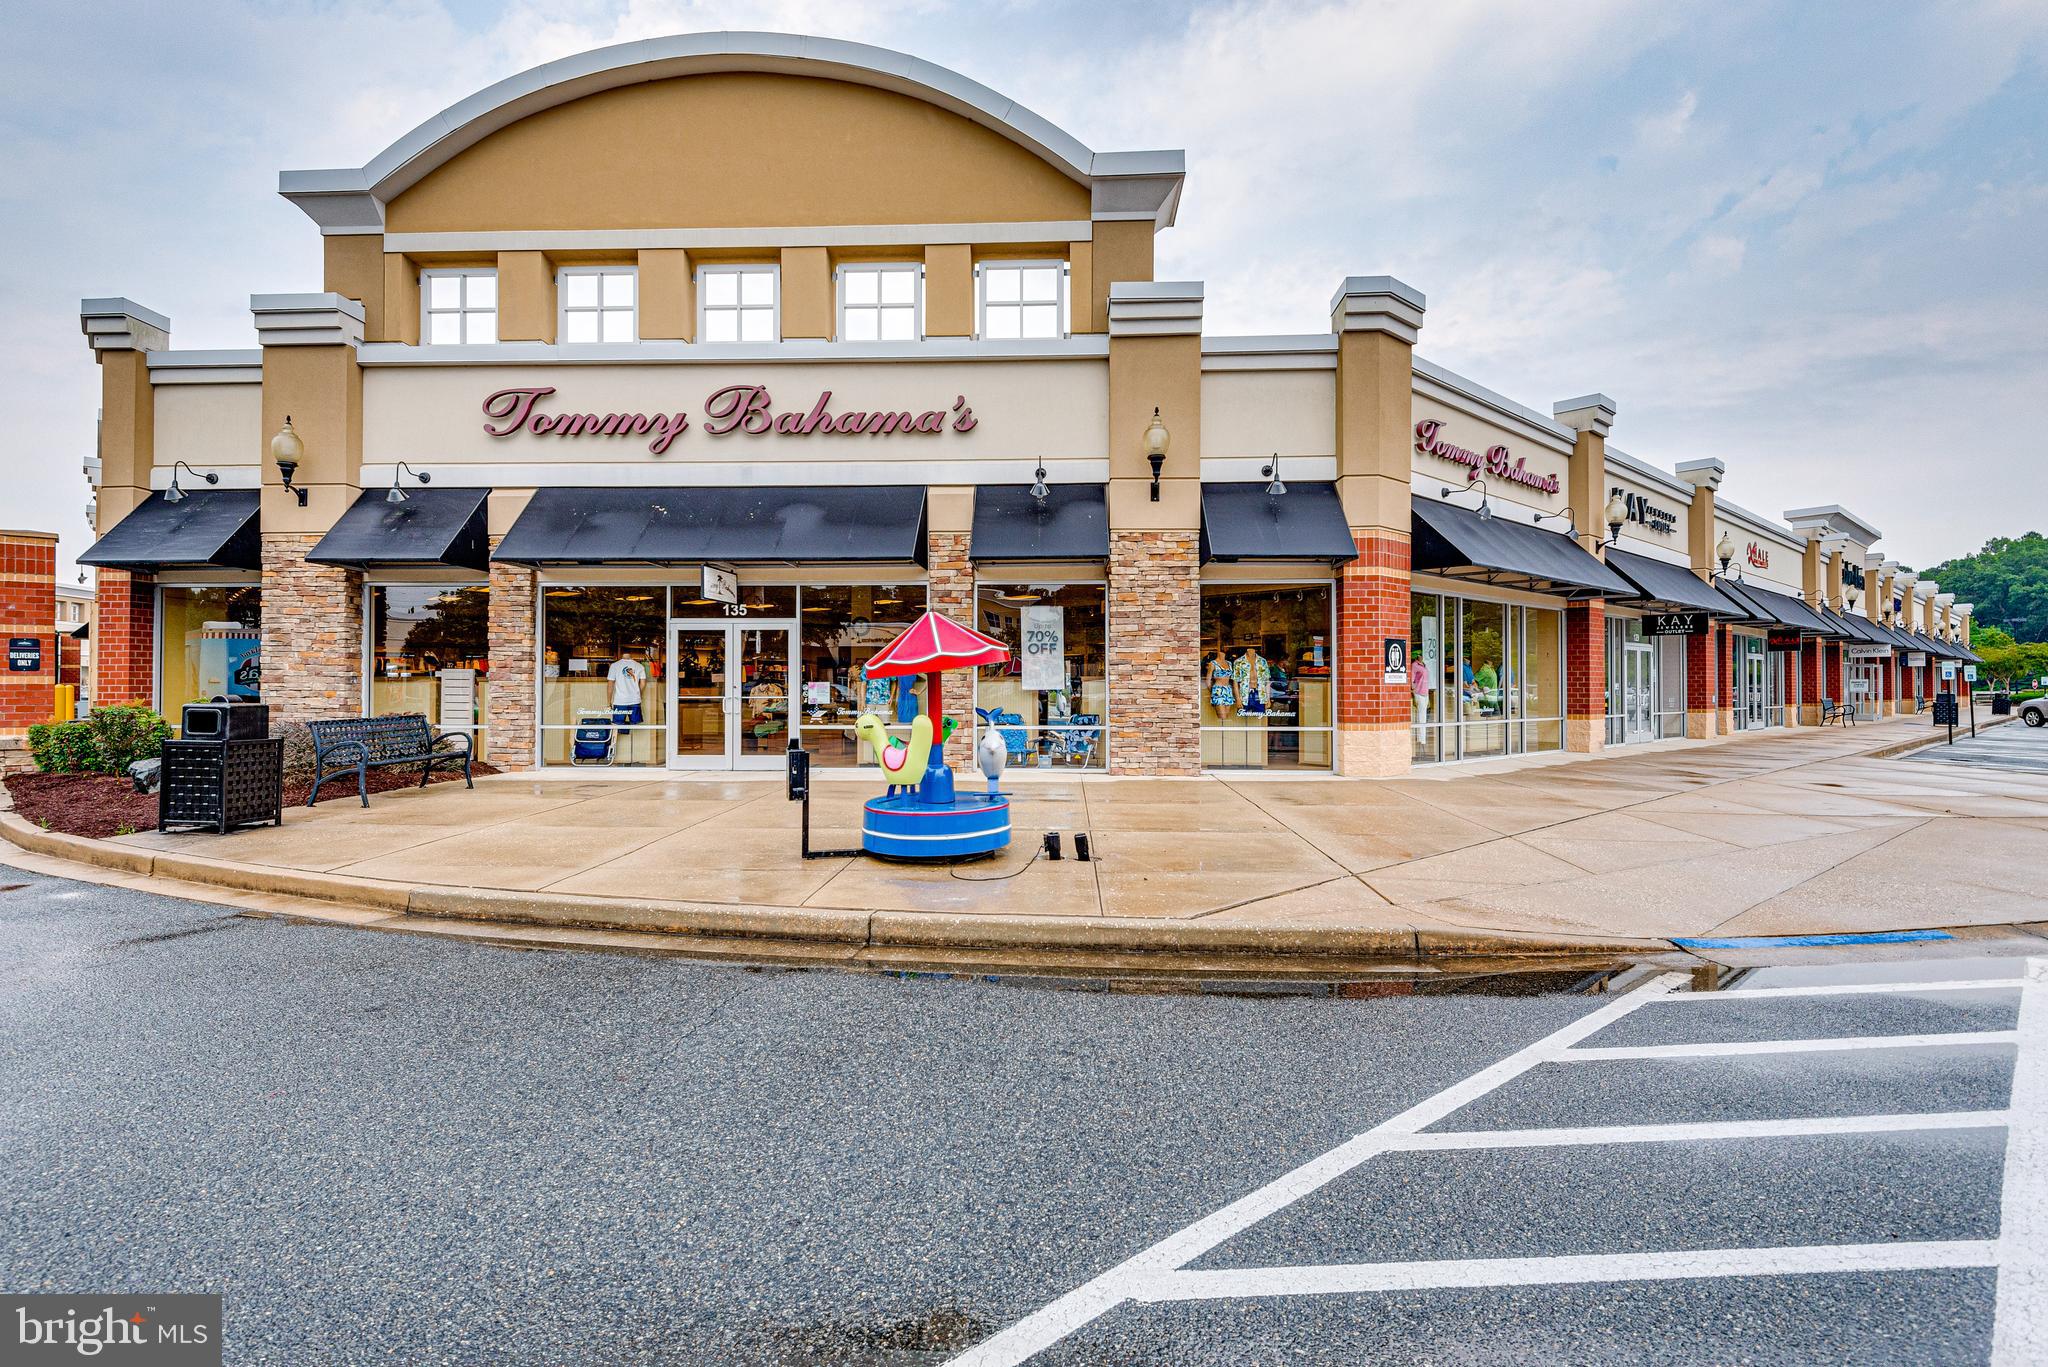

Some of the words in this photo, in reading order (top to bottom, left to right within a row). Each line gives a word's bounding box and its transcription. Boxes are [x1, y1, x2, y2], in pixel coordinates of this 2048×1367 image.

[482, 386, 689, 455] Tommy
[703, 384, 979, 435] Bahama's
[1414, 418, 1486, 482] Tommy
[1484, 444, 1561, 495] Bahama's
[722, 603, 748, 616] 135
[1657, 614, 1694, 626] KAY
[1026, 630, 1059, 643] 70%
[1027, 643, 1057, 655] OFF
[1851, 647, 1872, 655] Calvin
[1872, 647, 1889, 655] Klein
[17, 659, 32, 667] ONLY
[1236, 708, 1264, 720] Tommy
[1264, 708, 1297, 718] Bahama
